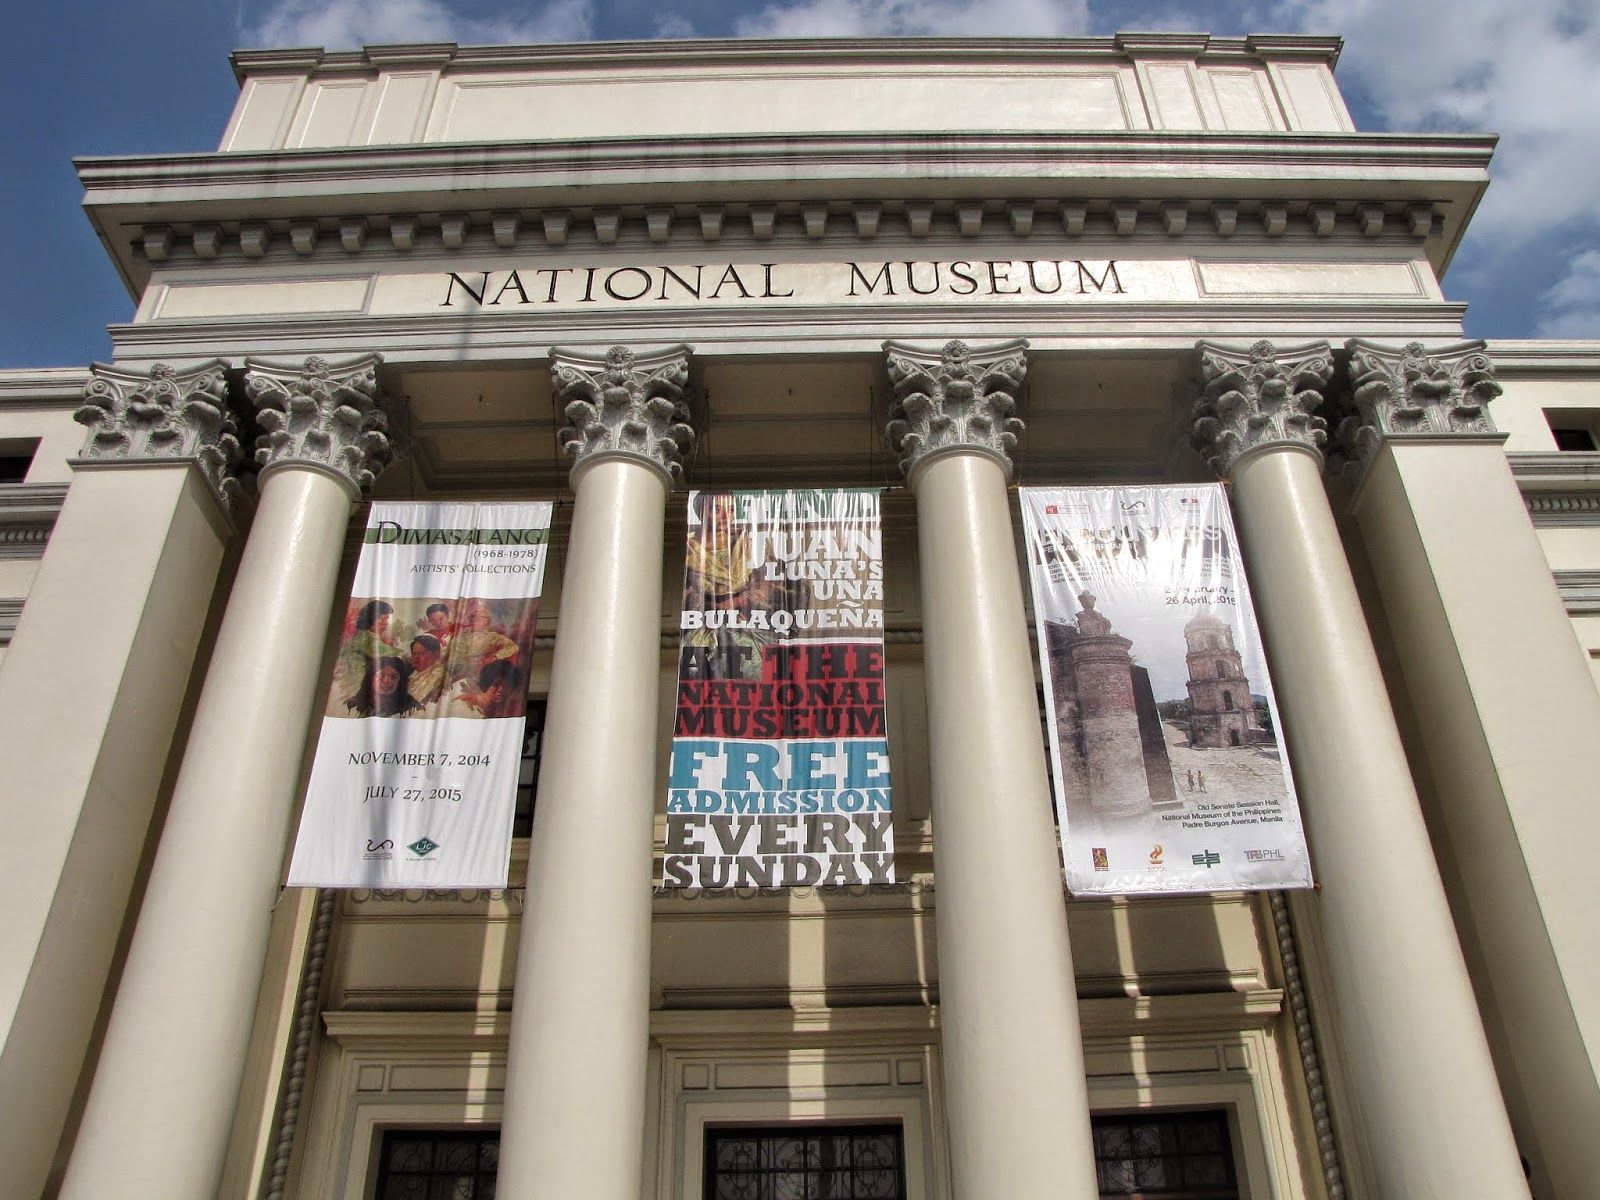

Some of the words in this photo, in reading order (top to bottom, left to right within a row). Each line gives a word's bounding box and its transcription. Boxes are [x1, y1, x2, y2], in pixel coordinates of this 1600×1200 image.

[439, 263, 794, 307] NATIONAL
[845, 260, 1128, 296] MUSEUM
[375, 521, 542, 545] DIMASALANG
[474, 549, 538, 560] (1968-1978)
[747, 529, 882, 569] JUAN
[410, 564, 459, 573] ARTISTS'
[765, 560, 883, 581] LUNA'S
[812, 580, 884, 600] UNA
[1166, 597, 1179, 605] 26
[1182, 596, 1211, 606] April,
[680, 601, 883, 636] BULAQUEÑA
[680, 646, 753, 680] AT
[763, 645, 883, 680] THE
[678, 681, 883, 706] NATIONAL
[675, 706, 885, 737] MUSEUM
[348, 752, 435, 766] NOVEMBER
[440, 753, 452, 767] 7,
[457, 754, 491, 767] 2014
[668, 740, 892, 790] FREE
[363, 786, 399, 803] JULY
[402, 788, 424, 802] 27,
[429, 788, 462, 802] 2015
[667, 788, 893, 814] ADMISSION
[1161, 813, 1190, 821] National
[1244, 808, 1282, 817] Philippines
[1182, 821, 1203, 829] Padre
[1204, 819, 1229, 828] Burgos
[1231, 817, 1259, 825] Avenue,
[665, 812, 893, 855] EVERY
[664, 853, 895, 888] SUNDAY
